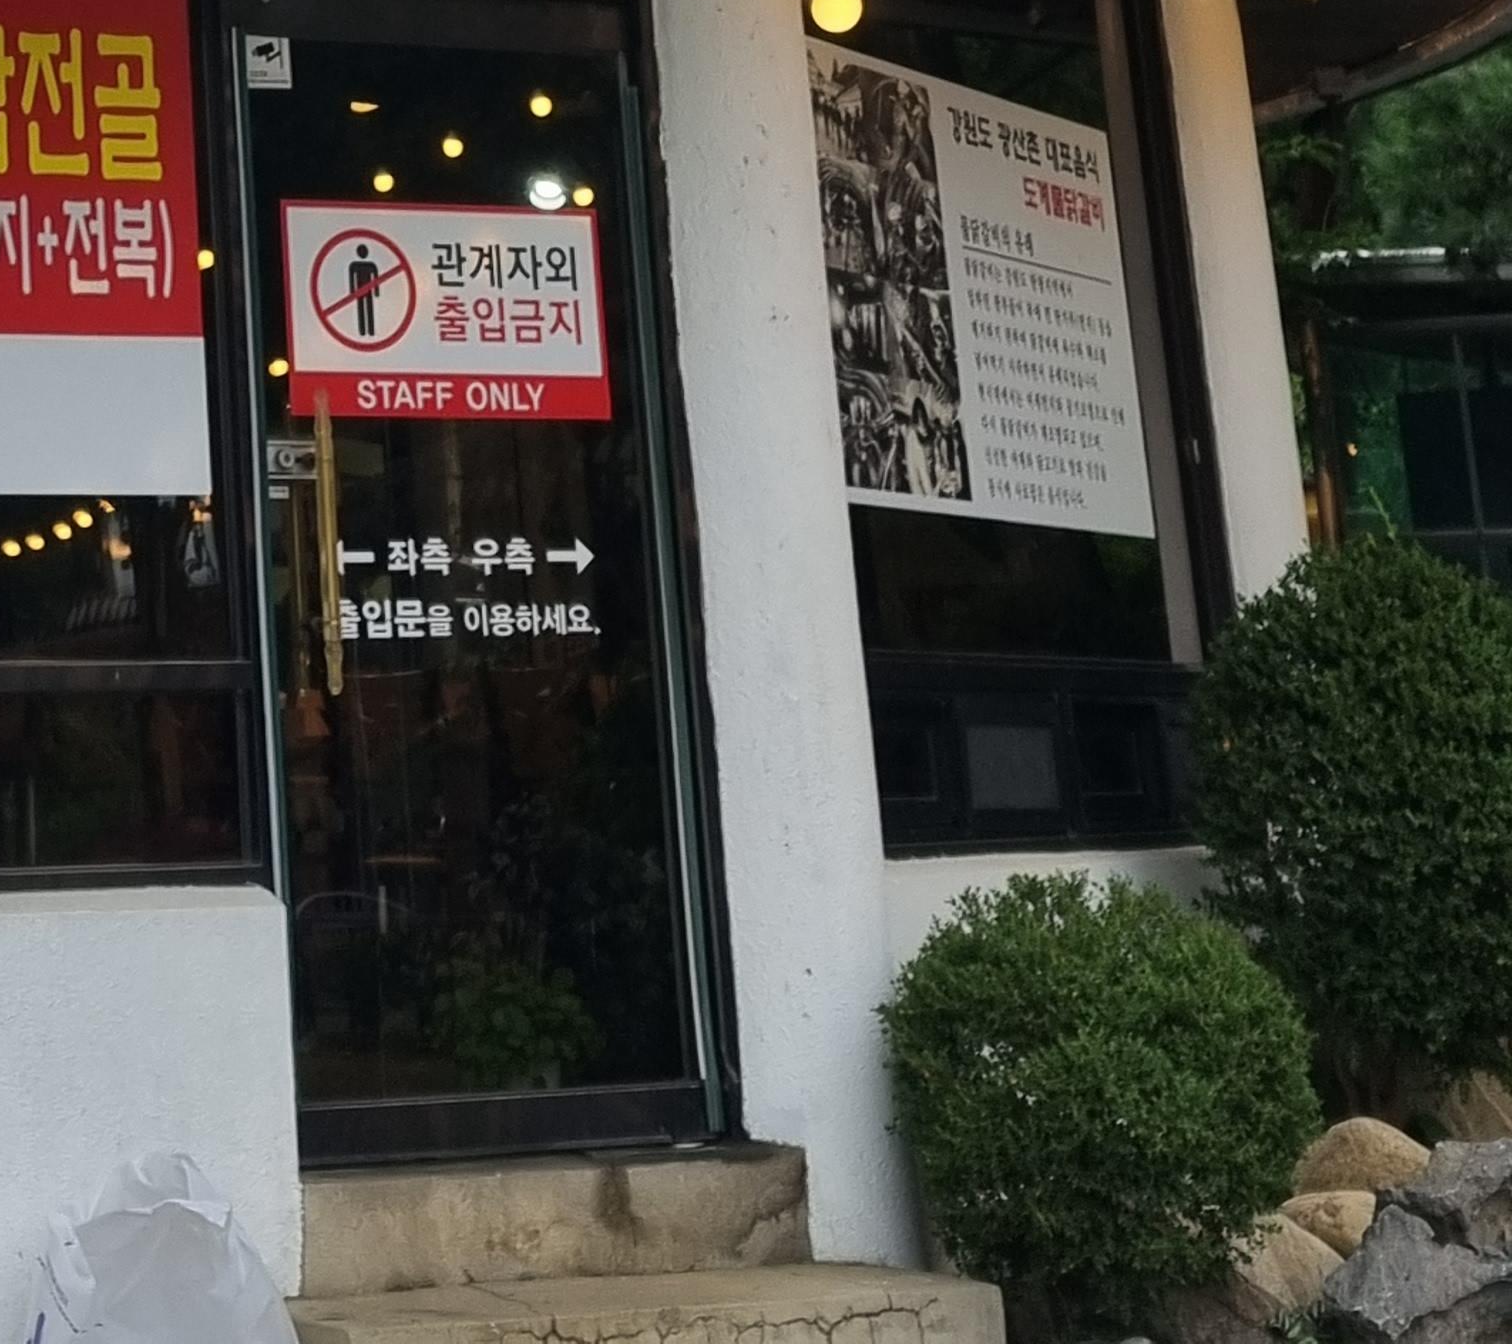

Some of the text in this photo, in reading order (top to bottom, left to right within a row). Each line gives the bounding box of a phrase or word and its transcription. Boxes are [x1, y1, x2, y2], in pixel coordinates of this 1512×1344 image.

[947, 106, 993, 149] 강원도
[431, 243, 578, 292] 관계자외
[434, 296, 582, 345] 출입금지
[357, 379, 545, 412] STAFF ONLY
[387, 537, 536, 577] 좌측 우측
[464, 603, 602, 638] 이용하세요.
